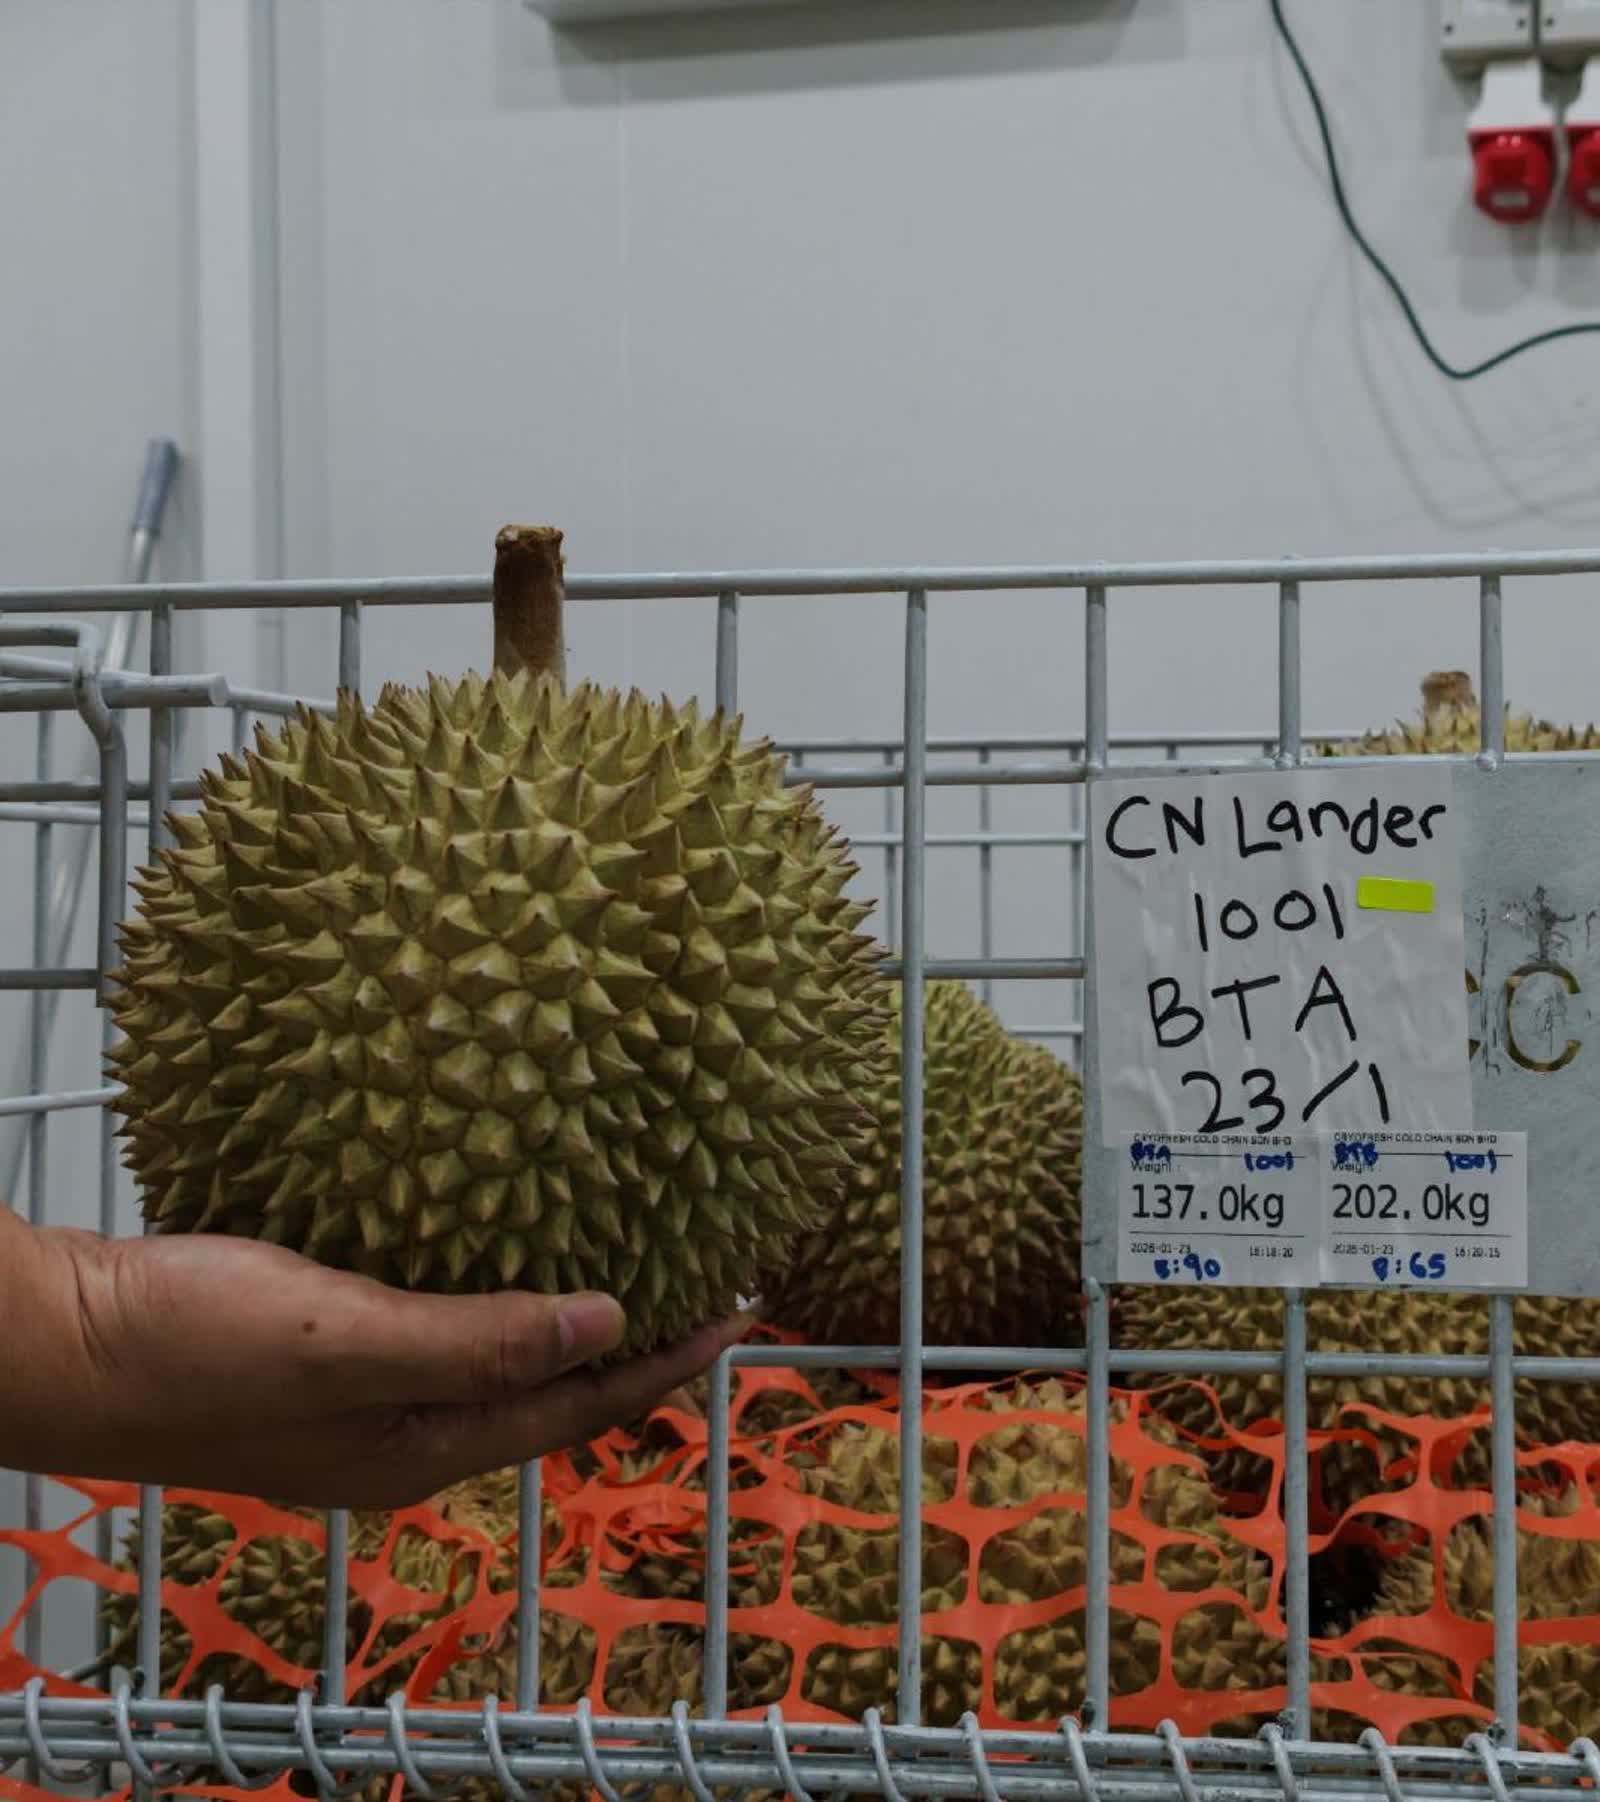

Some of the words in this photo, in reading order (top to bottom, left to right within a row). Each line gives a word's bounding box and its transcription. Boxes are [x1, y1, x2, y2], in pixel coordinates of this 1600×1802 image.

[1106, 796, 1205, 858] CN
[1234, 796, 1446, 857] Lander
[1194, 883, 1343, 952] 1001
[1194, 1135, 1219, 1145] COLD
[1222, 1135, 1248, 1145] CHAIN
[1395, 1134, 1422, 1143] COLD
[1424, 1135, 1453, 1144] CHAIN
